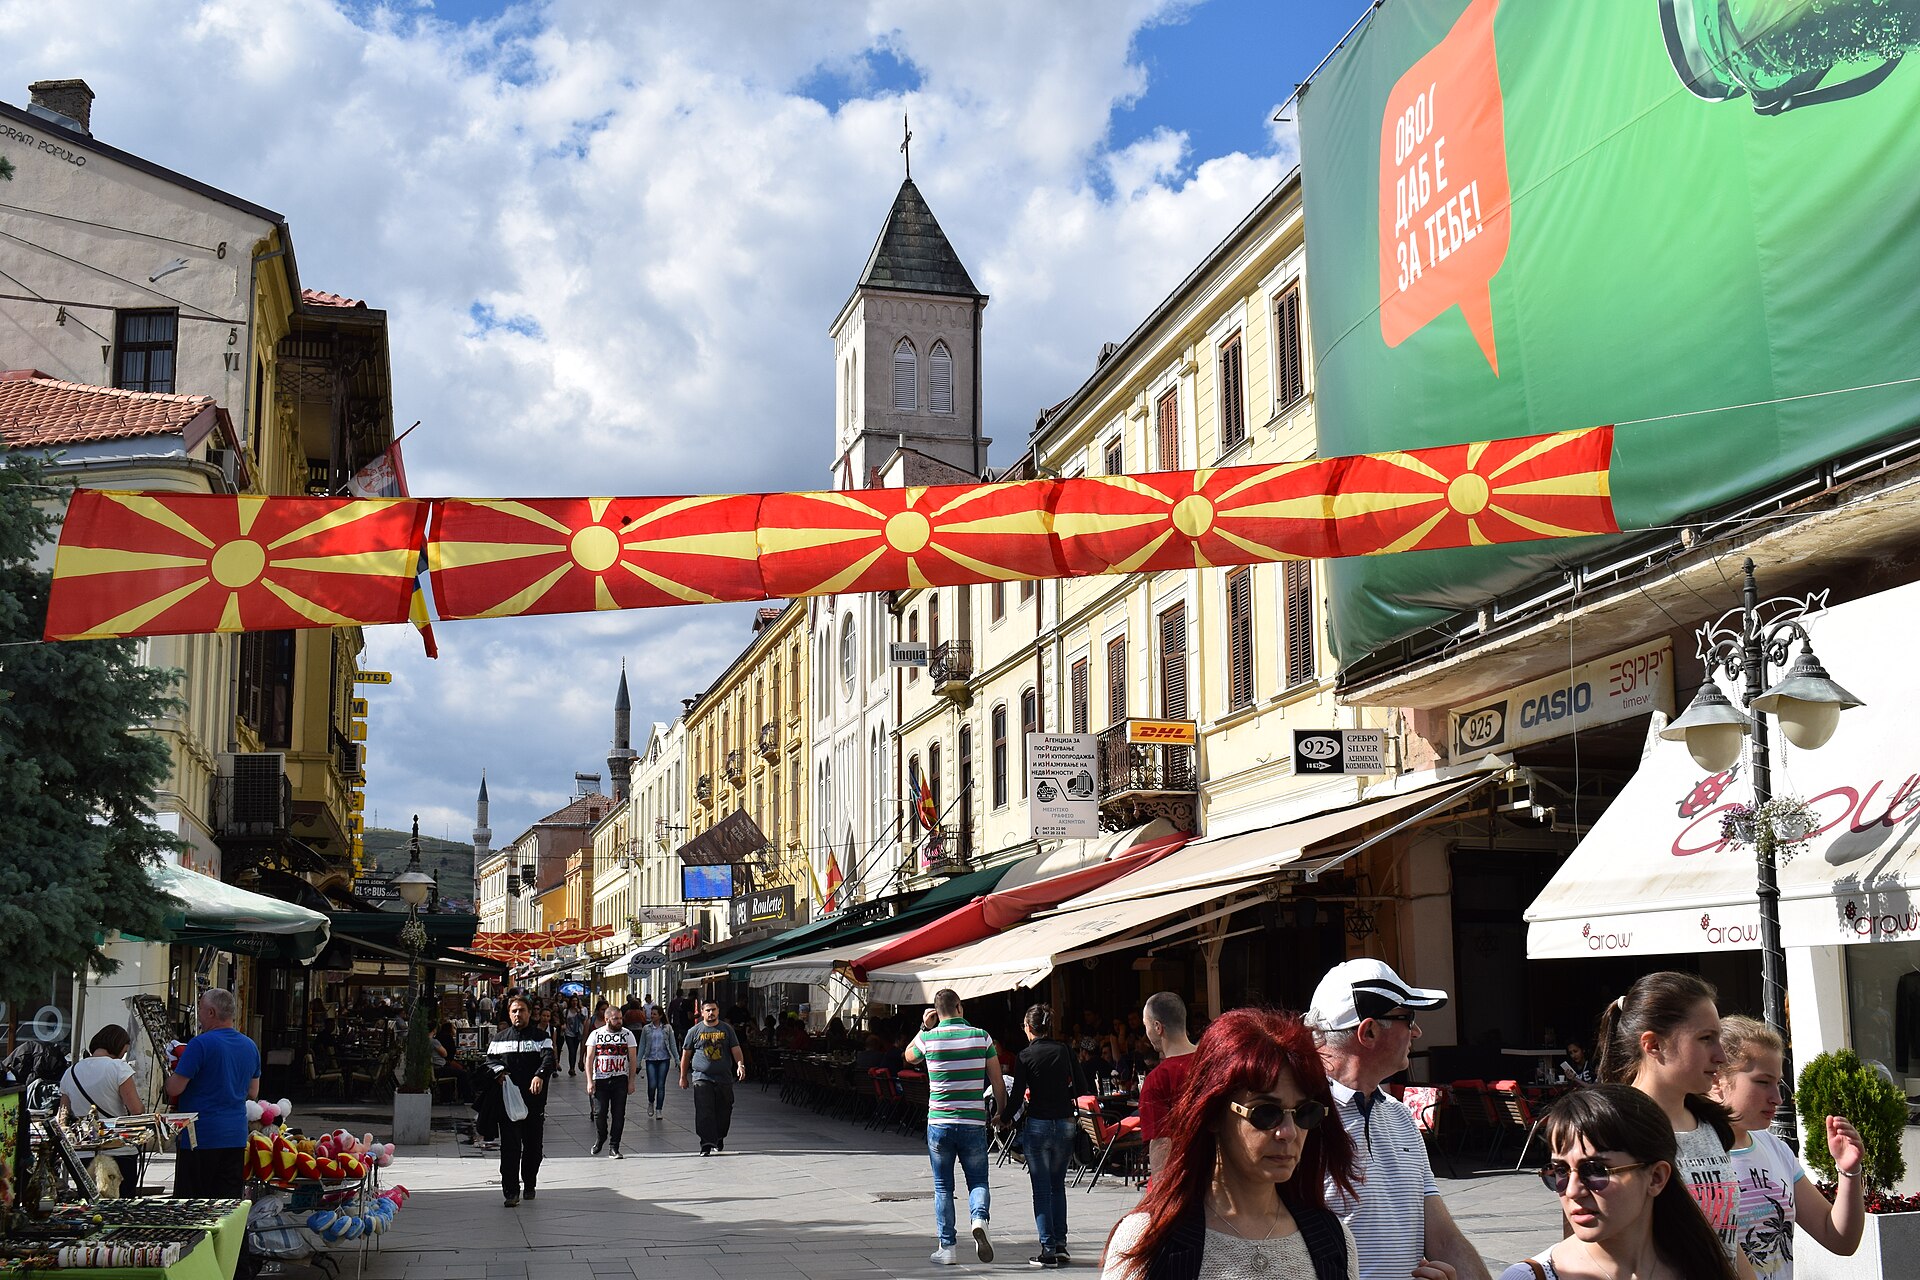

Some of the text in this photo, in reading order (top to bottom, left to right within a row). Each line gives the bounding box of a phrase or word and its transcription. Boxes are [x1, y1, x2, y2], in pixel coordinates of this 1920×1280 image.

[1395, 81, 1436, 167] ОВОЈ
[0, 124, 86, 167] ORAM POPULO
[1395, 135, 1448, 238] ДАБ Е
[1397, 180, 1483, 292] ЗА ТЕБЕ!
[217, 242, 227, 259] 6
[56, 306, 67, 327] 4
[227, 327, 238, 346] 5
[223, 353, 241, 372] VI
[1519, 682, 1592, 729] CASIO
[1138, 726, 1188, 739] DHL
[1469, 713, 1492, 742] 925
[1045, 736, 1072, 744] АГЕНЦИЈА
[1304, 740, 1335, 756] 925
[1346, 734, 1378, 742] СРЕБРО
[1347, 744, 1378, 752] SILVER
[752, 895, 783, 915] Roulette
[1749, 1168, 1772, 1190] ME
